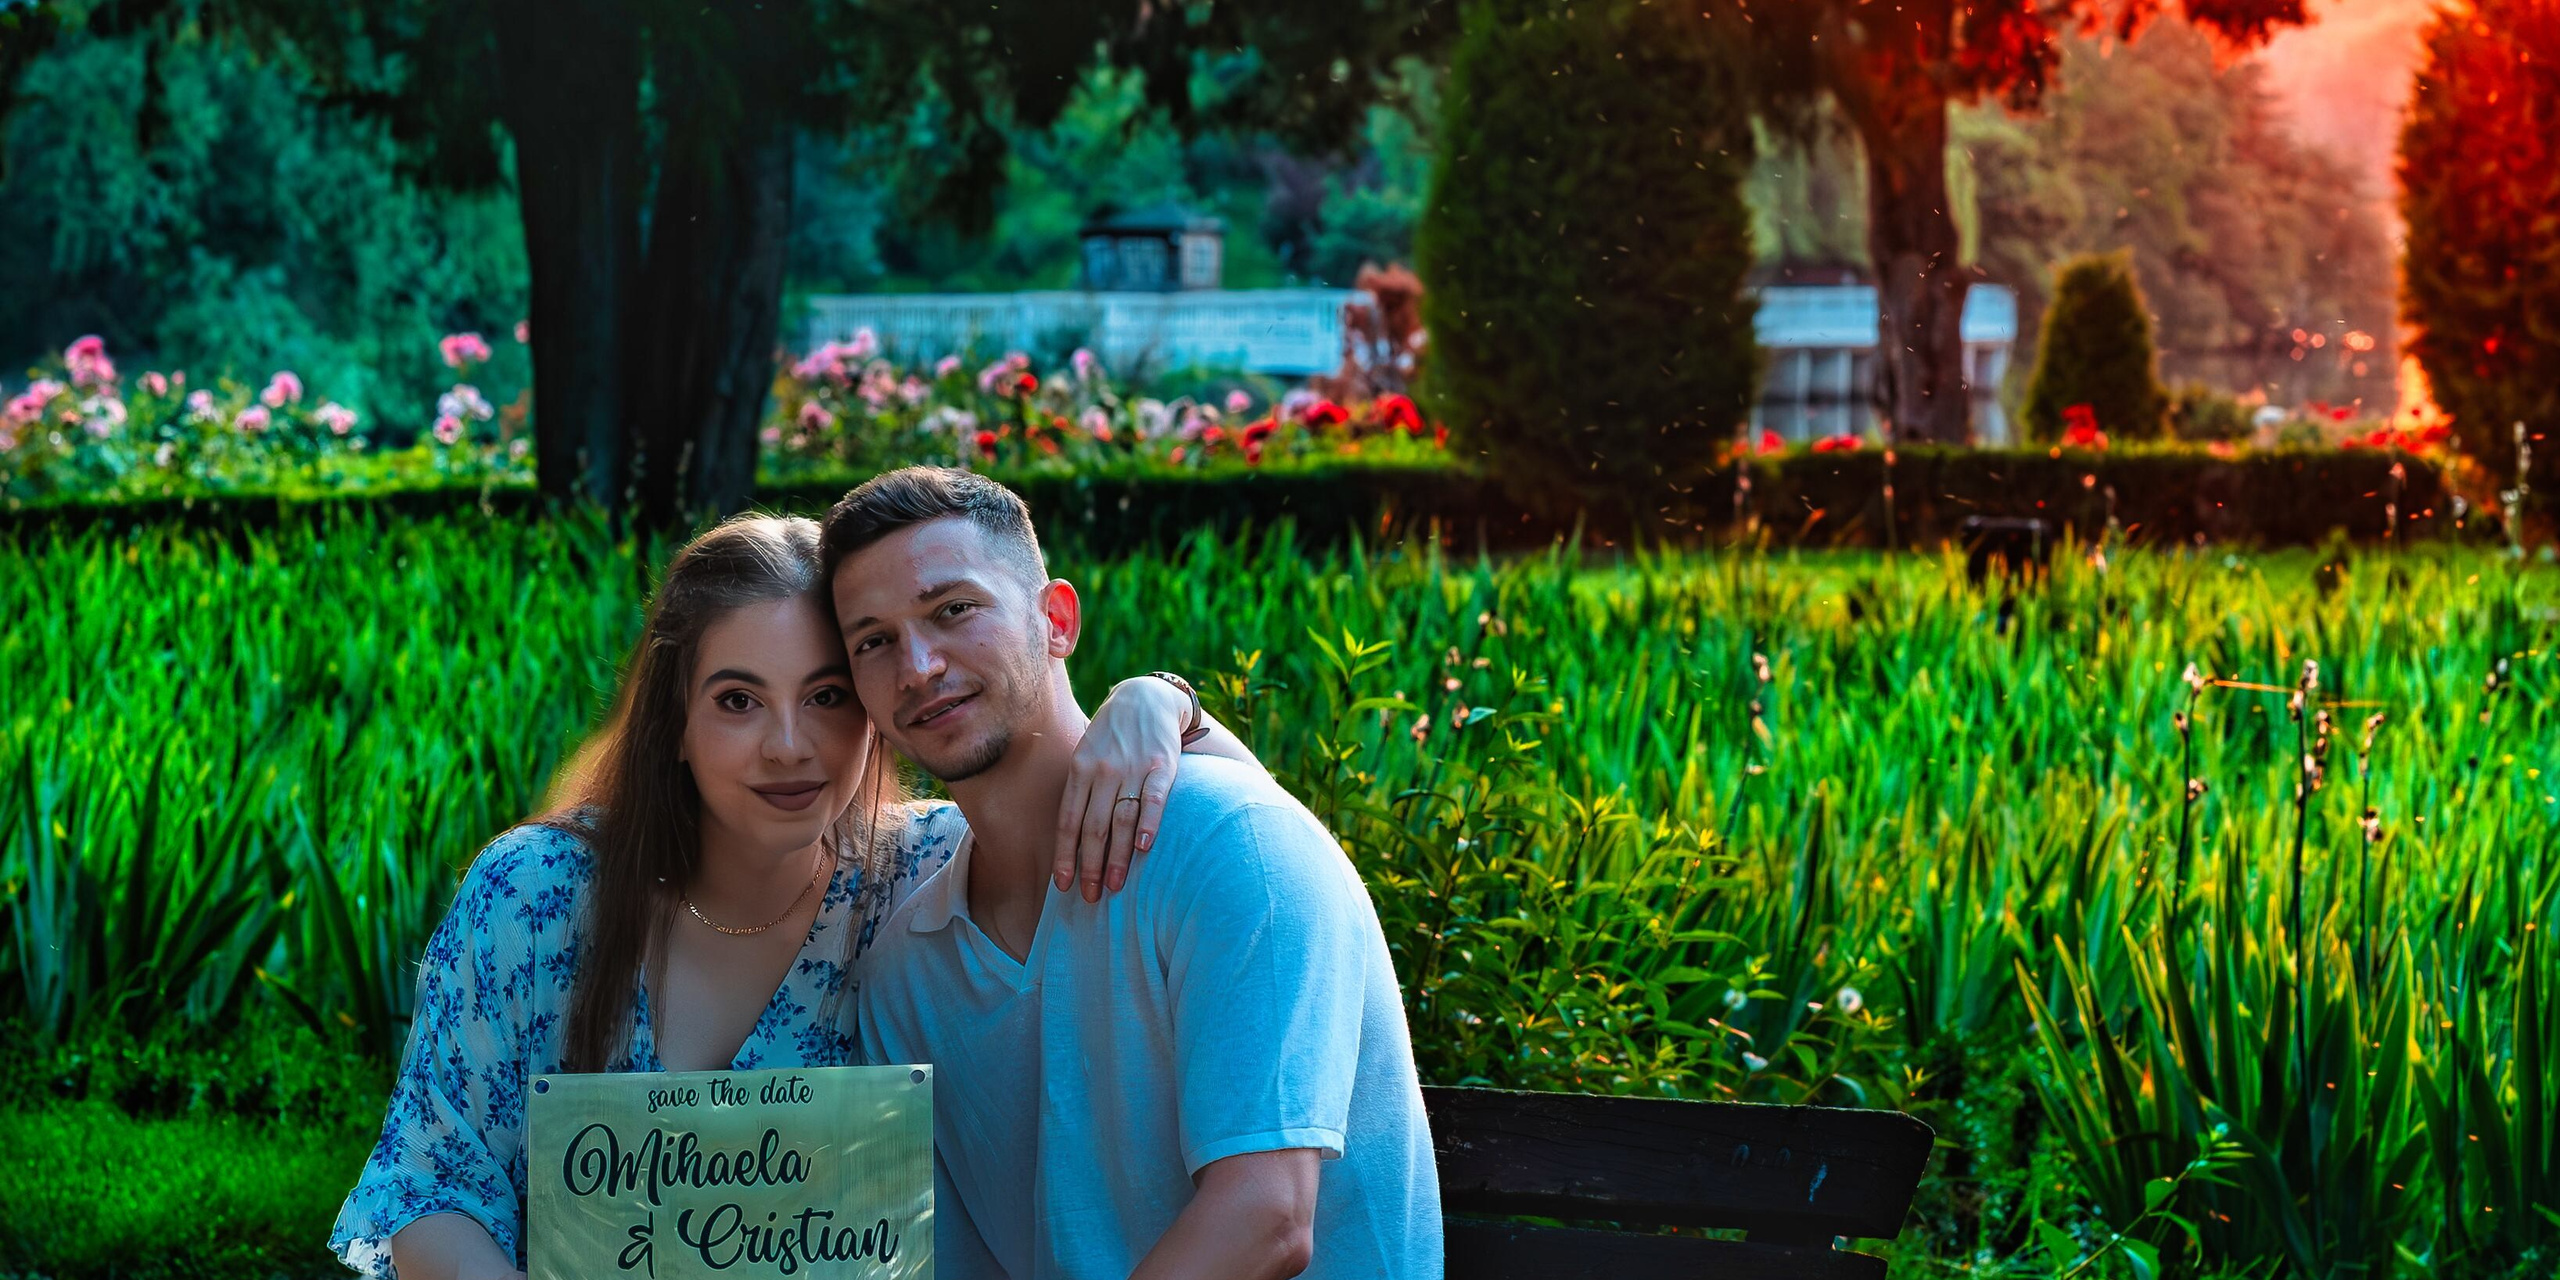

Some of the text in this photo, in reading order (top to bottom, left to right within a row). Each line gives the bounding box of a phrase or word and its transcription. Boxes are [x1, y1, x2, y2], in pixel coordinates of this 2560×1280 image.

[648, 1075, 814, 1113] save the date
[563, 1123, 811, 1206] Mihaela
[617, 1203, 900, 1279] & Cristian
